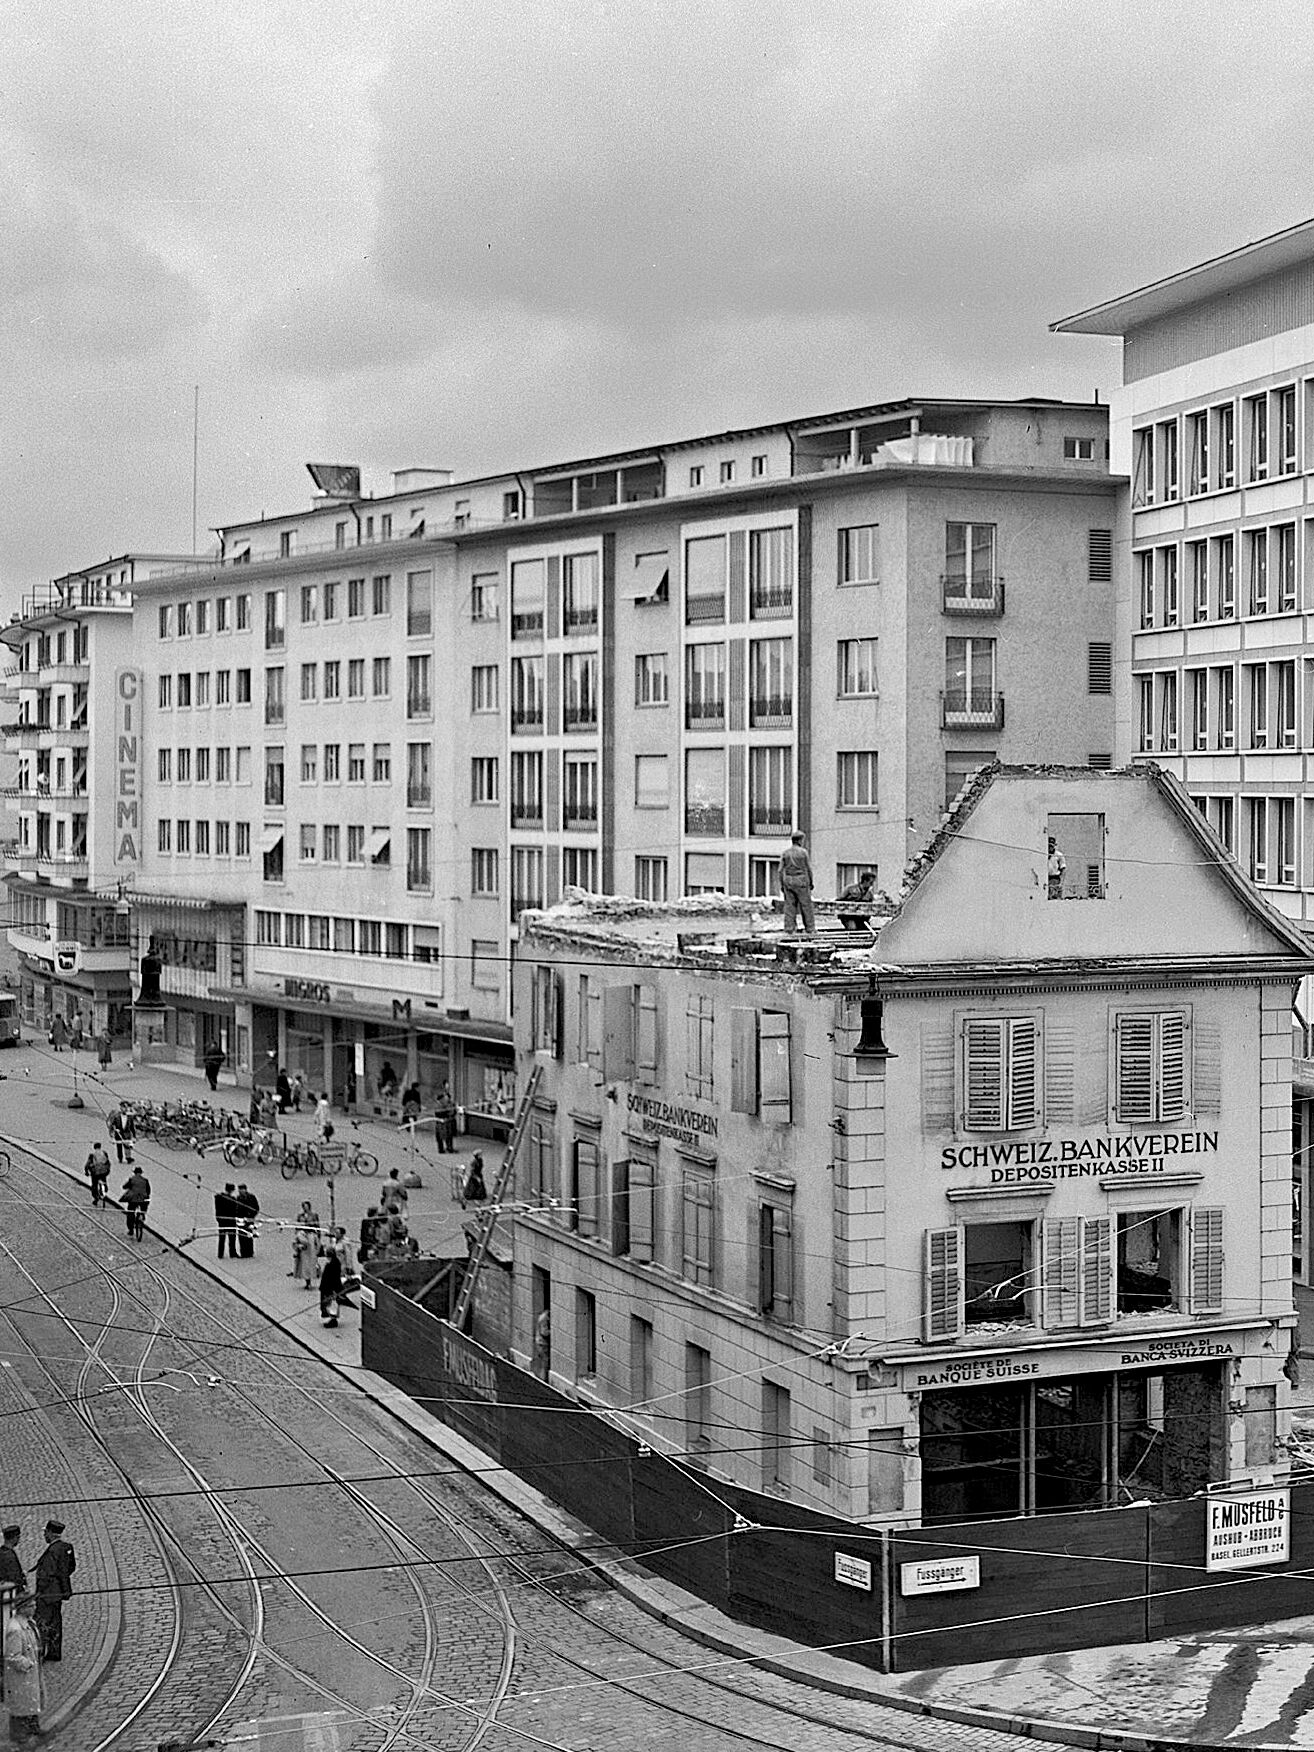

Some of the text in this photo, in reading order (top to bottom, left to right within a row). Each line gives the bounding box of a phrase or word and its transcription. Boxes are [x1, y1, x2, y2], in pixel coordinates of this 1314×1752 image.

[118, 671, 138, 861] CINEMA
[392, 998, 412, 1021] M
[991, 1158, 1150, 1183] DEPOSITENKASSE
[996, 1358, 1012, 1368] DE
[1121, 1343, 1233, 1365] BANCA SVIZZERA
[917, 1363, 1040, 1385] BANQUE SUISSE
[1271, 1543, 1284, 1553] 224
[916, 1565, 965, 1581] Fussgänger
